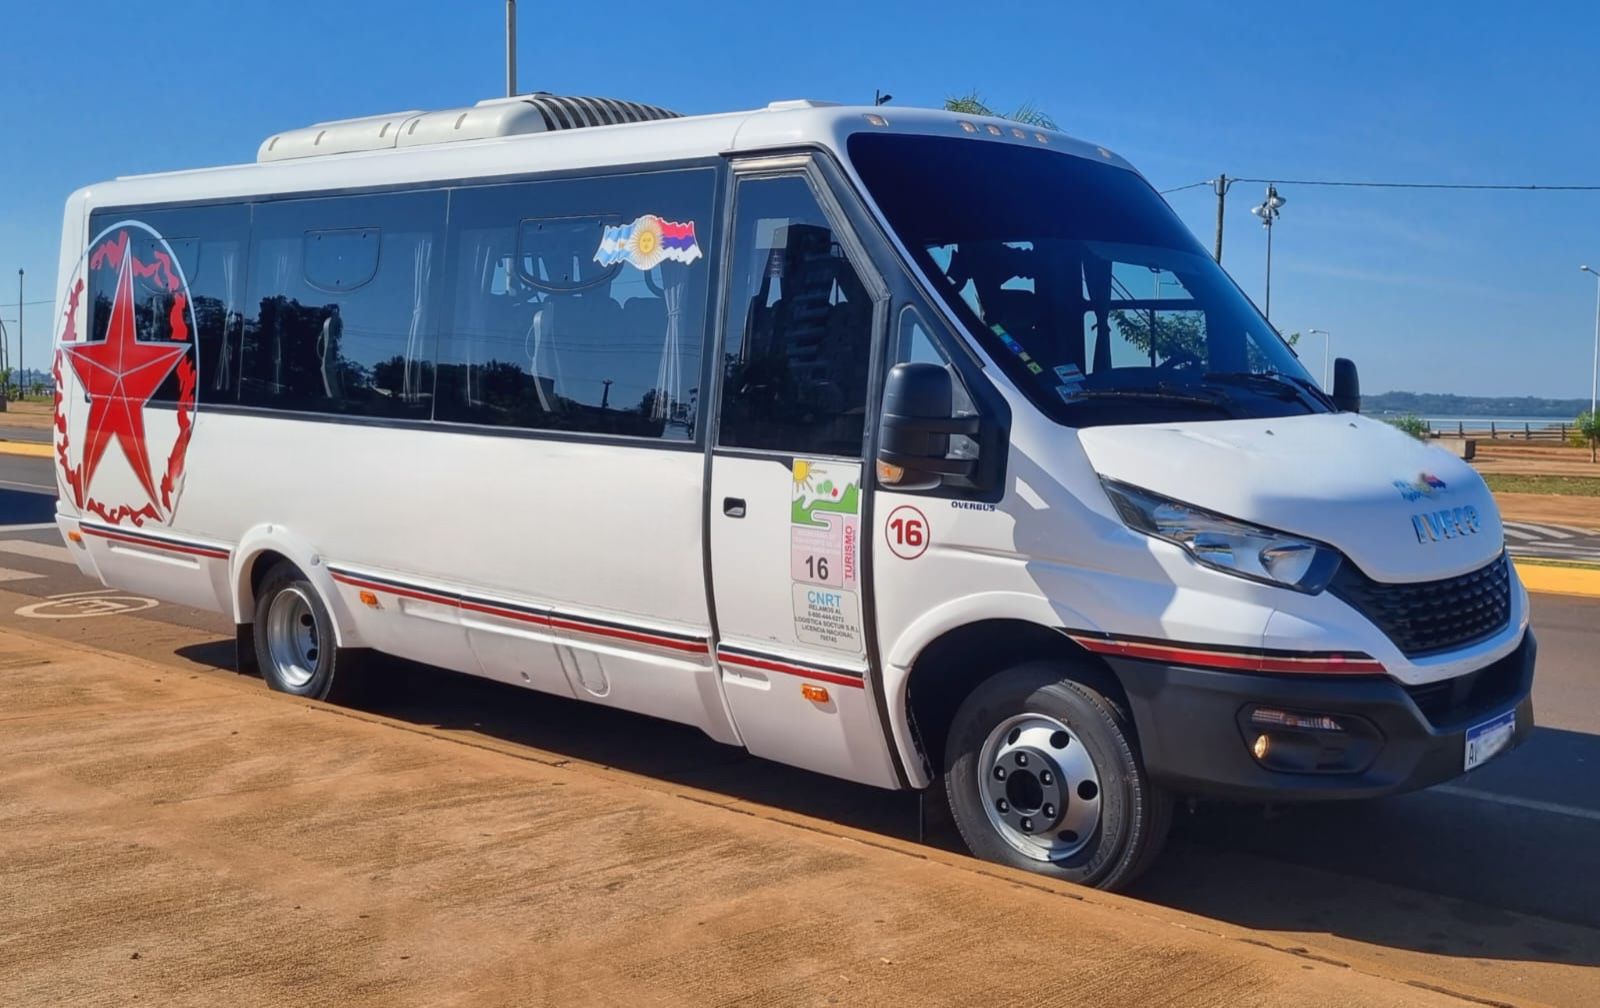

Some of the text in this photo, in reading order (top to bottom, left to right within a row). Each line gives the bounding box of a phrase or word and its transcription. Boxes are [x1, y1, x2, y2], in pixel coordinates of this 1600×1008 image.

[951, 501, 996, 512] OVERBUS
[890, 518, 923, 547] 16
[1411, 505, 1481, 544] IVECO
[844, 525, 853, 579] TURISMO
[805, 555, 829, 581] 16
[807, 590, 842, 607] CNRT
